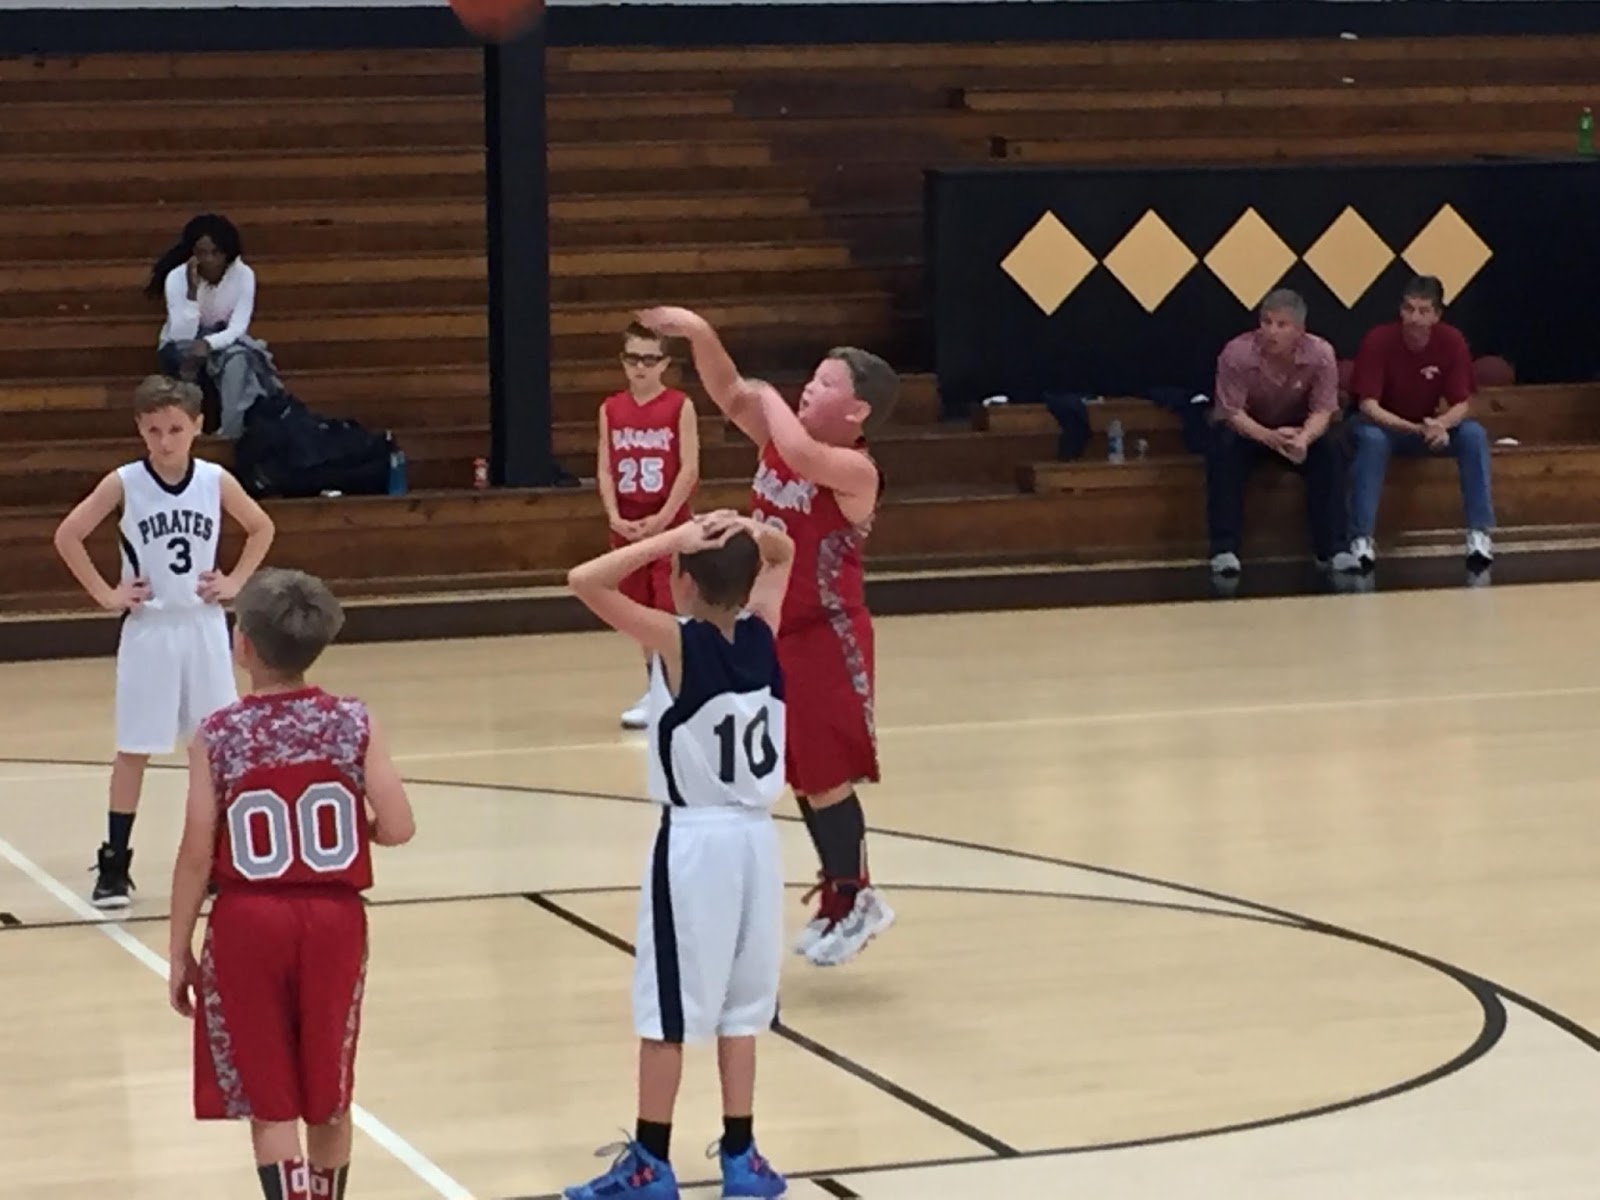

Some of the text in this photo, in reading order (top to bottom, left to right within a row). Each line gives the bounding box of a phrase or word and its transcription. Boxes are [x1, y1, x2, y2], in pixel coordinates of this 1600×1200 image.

[618, 456, 665, 494] 25
[138, 509, 213, 545] PIRATES
[167, 536, 192, 575] 3
[713, 705, 779, 784] 10
[227, 781, 359, 880] 00
